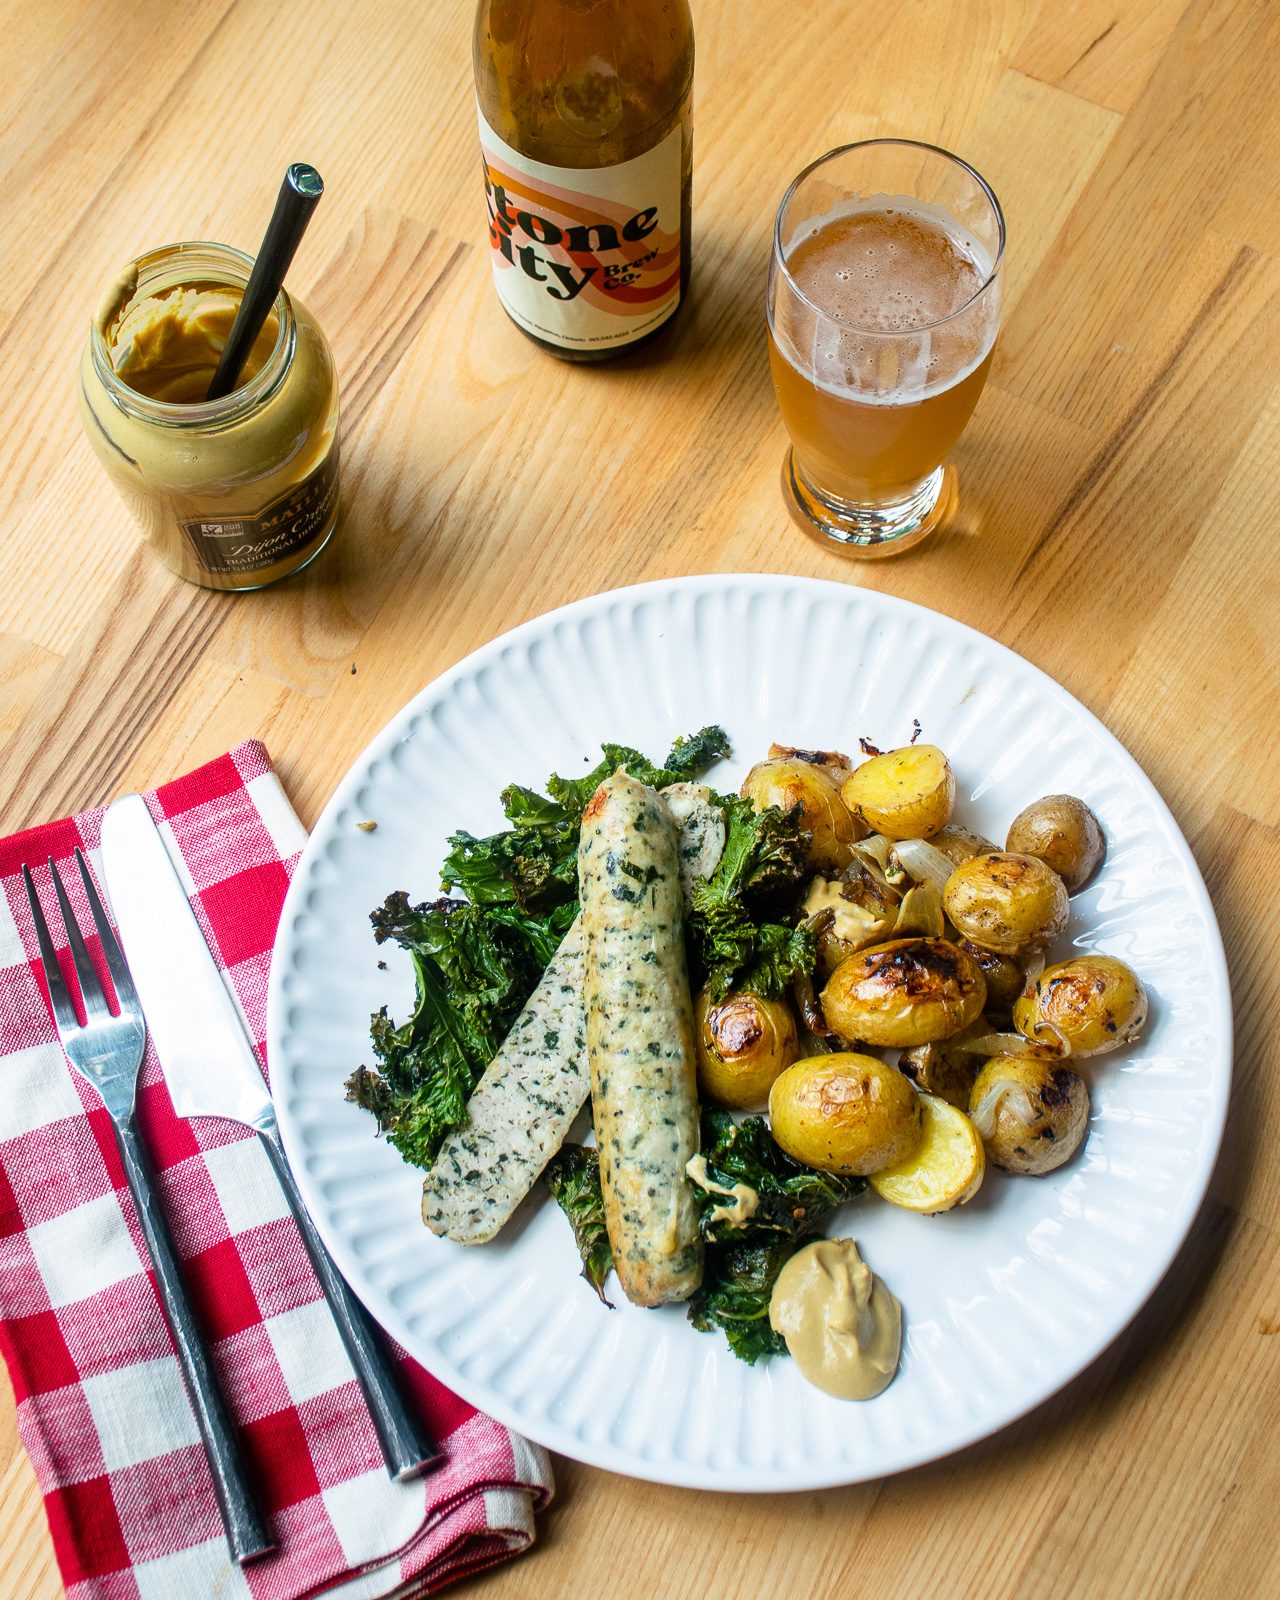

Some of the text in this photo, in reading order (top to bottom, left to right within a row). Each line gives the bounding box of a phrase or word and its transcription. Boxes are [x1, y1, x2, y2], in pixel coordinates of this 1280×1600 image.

[483, 152, 659, 252] tone
[486, 197, 599, 301] ity
[604, 247, 660, 277] Brew
[603, 273, 642, 290] Co.
[223, 531, 289, 557] Dijon
[224, 538, 297, 565] TRADITIONAL
